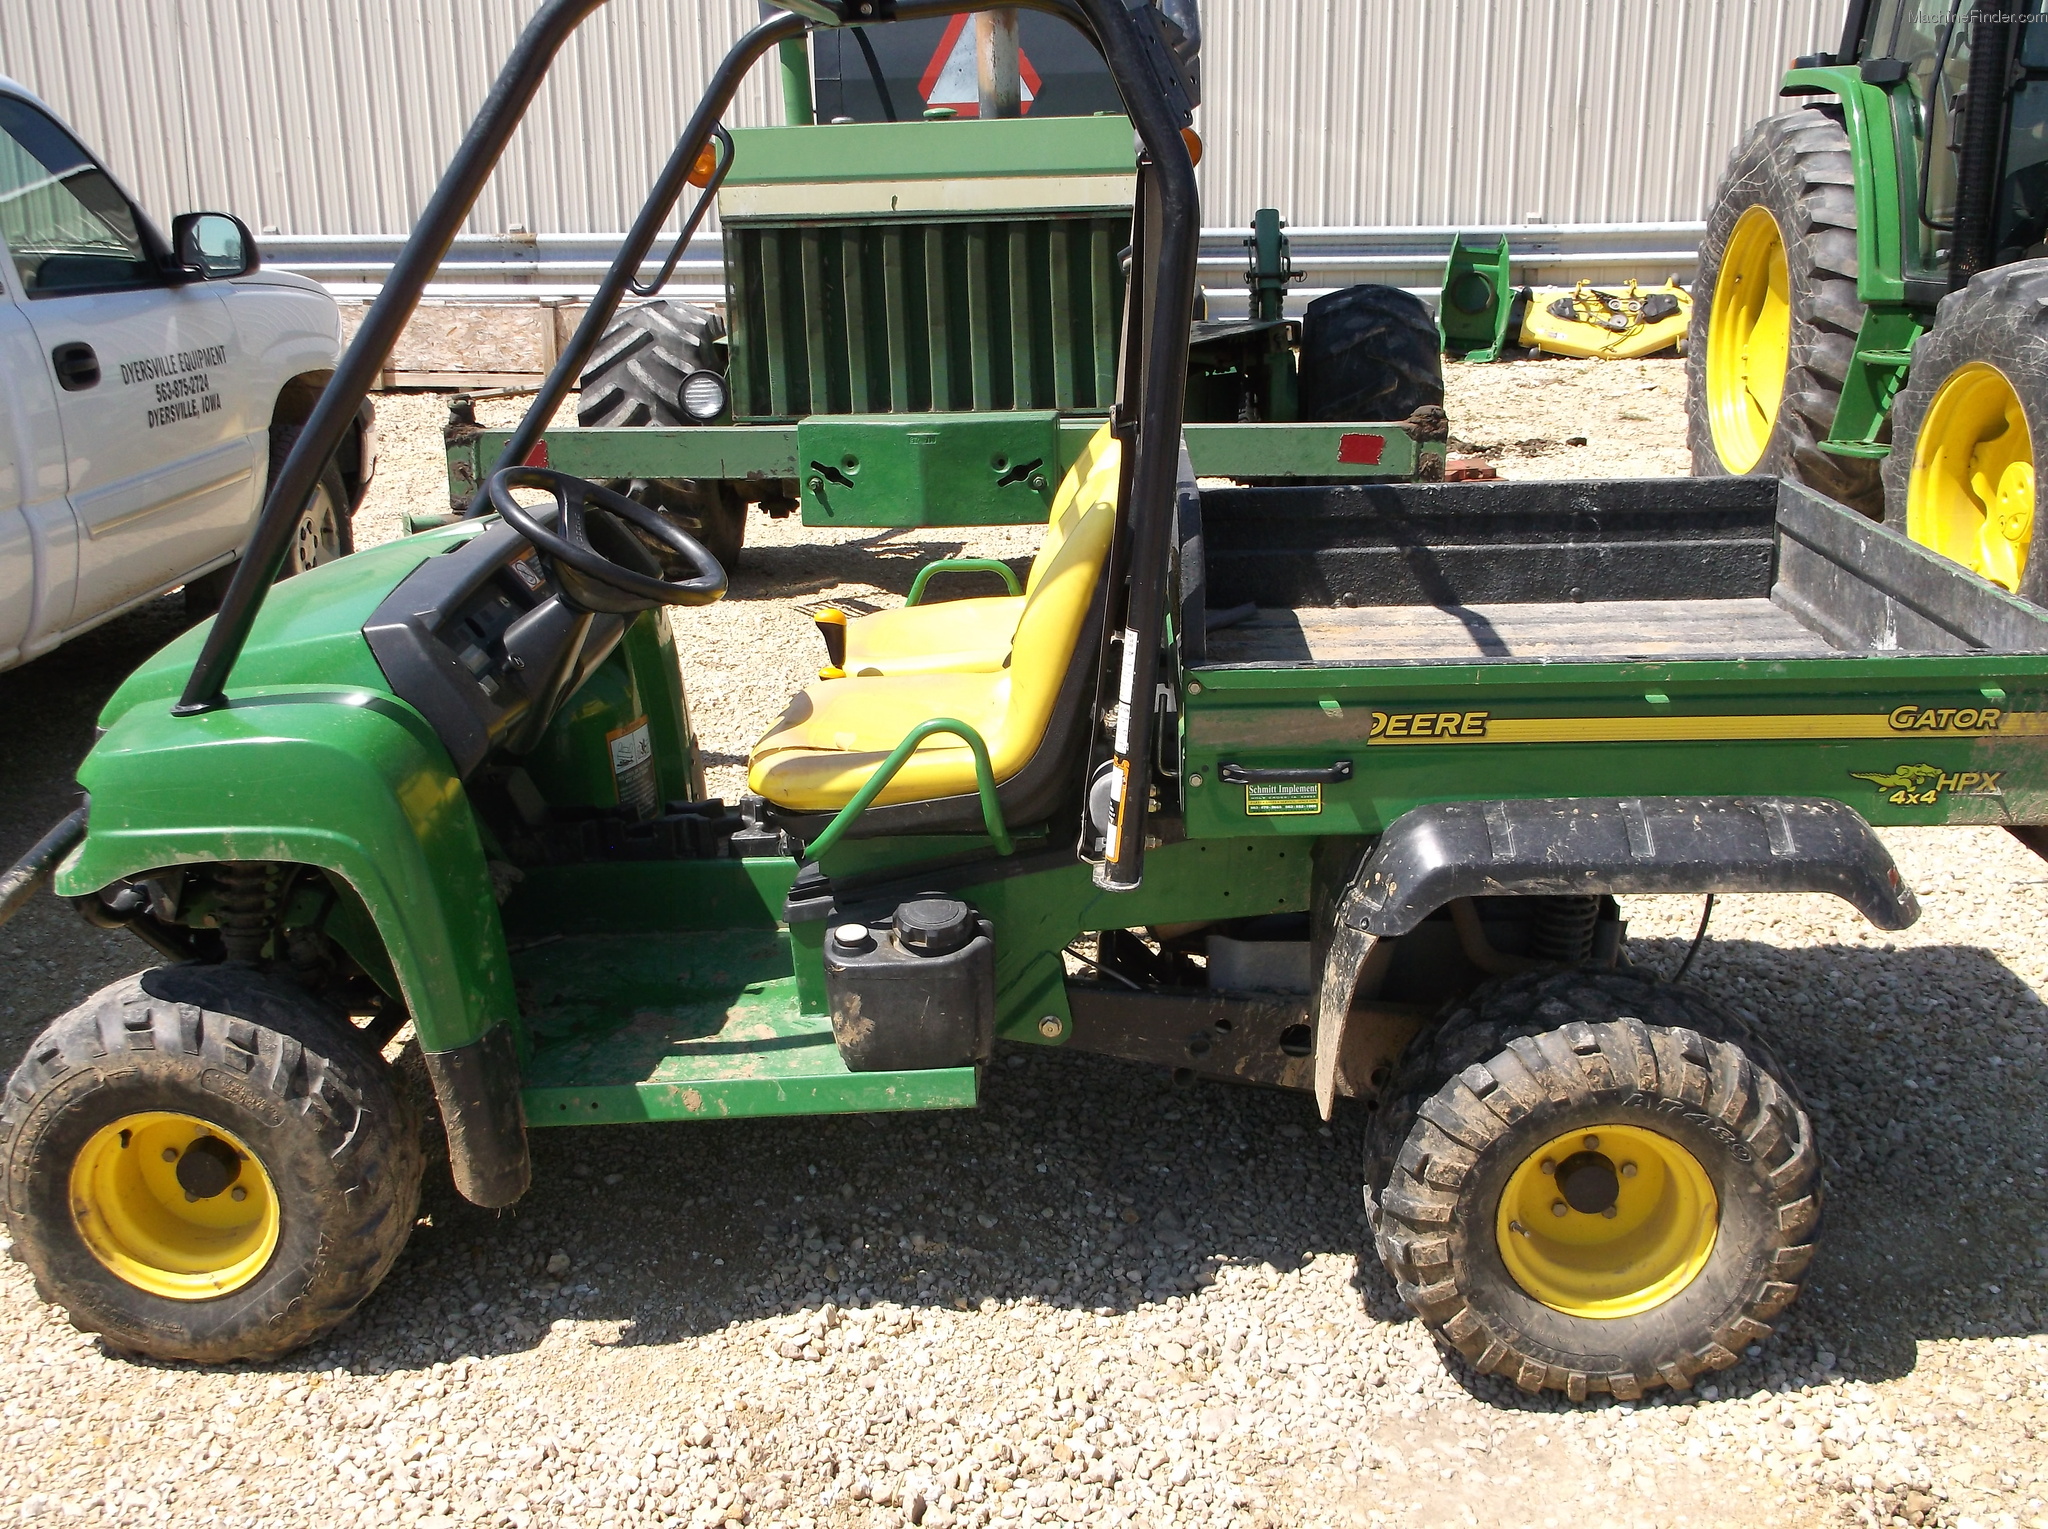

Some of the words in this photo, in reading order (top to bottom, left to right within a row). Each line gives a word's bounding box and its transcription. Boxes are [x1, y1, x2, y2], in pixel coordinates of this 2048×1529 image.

[121, 355, 178, 385] DYERSVILLE
[178, 345, 227, 372] EQUIPMENT
[155, 374, 209, 403] 563-875-2724
[148, 399, 200, 428] DYERSVILLE,
[201, 393, 222, 414] IOWA
[1249, 785, 1277, 794] Schmitt
[1279, 784, 1317, 795] Implement
[1935, 772, 2002, 792] HPX
[1889, 790, 1938, 805] 4x4
